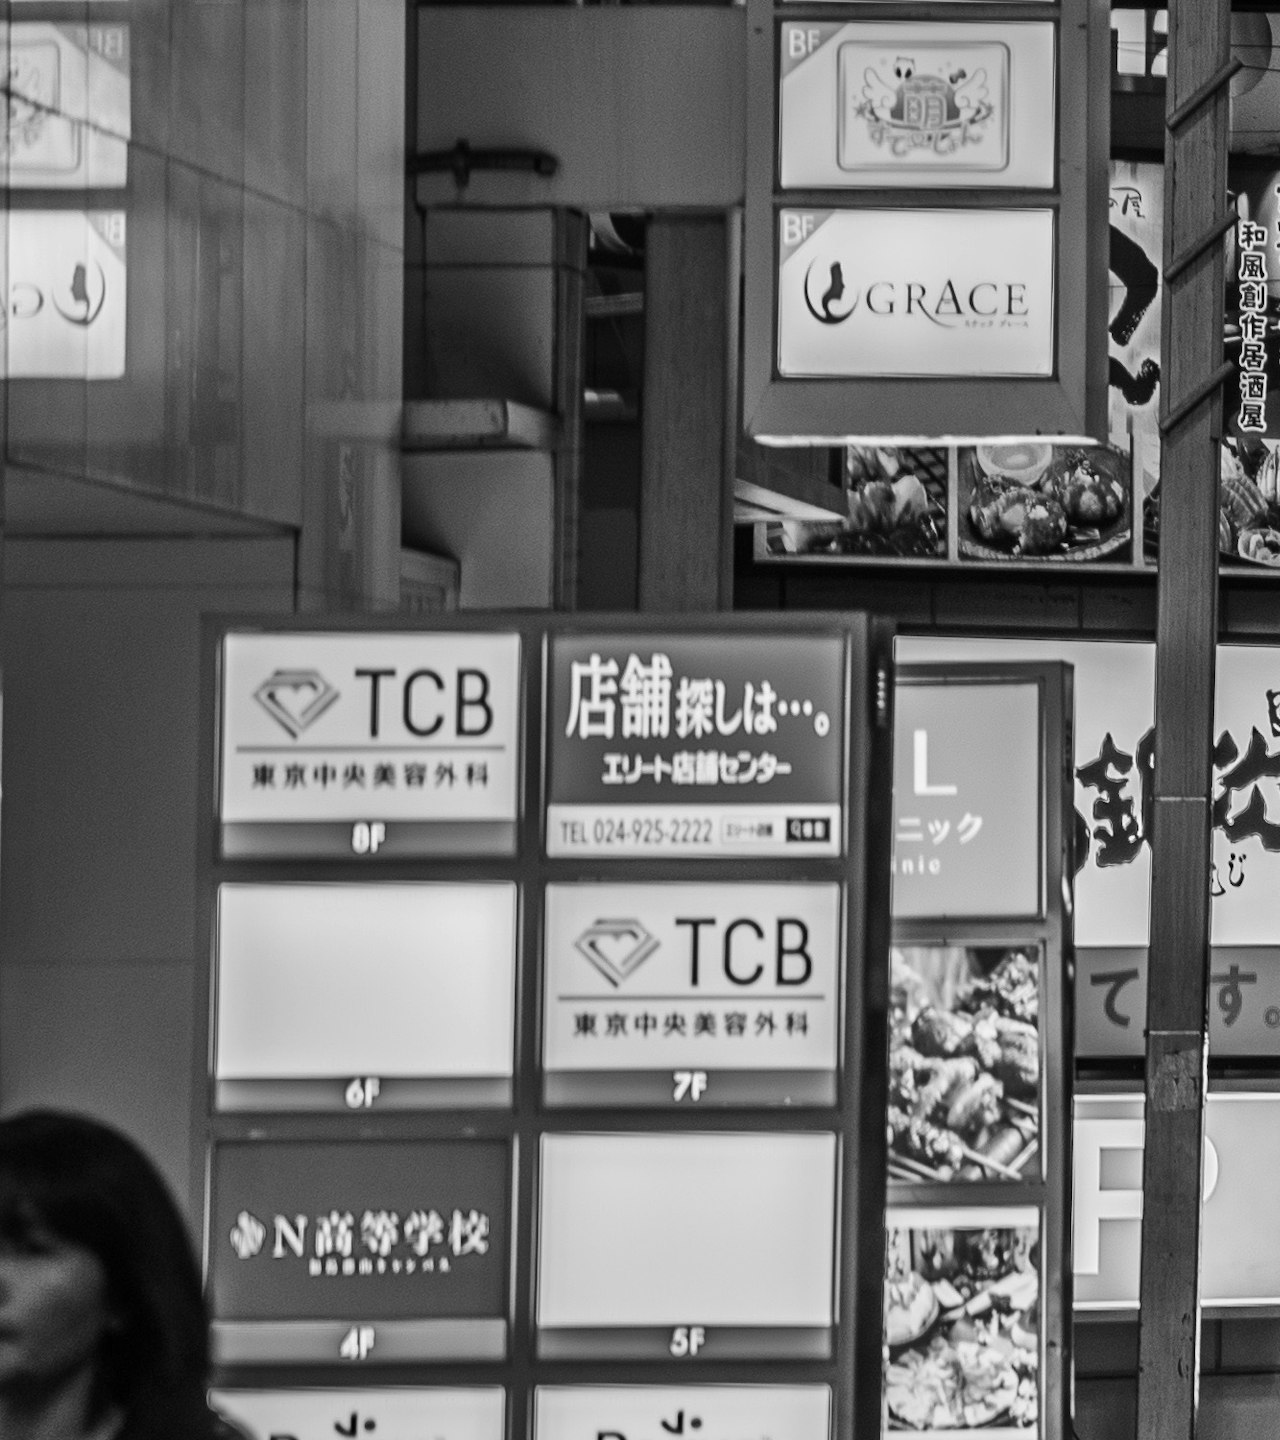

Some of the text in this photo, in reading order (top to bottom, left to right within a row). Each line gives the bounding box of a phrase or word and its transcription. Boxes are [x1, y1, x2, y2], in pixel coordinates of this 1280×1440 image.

[788, 28, 821, 60] BF
[783, 213, 815, 246] BF
[865, 278, 1030, 328] GRACE
[1238, 220, 1267, 434] 和風創作居酒屋
[354, 666, 494, 739] TCB
[251, 761, 489, 790] 東京中央美容外科
[600, 748, 793, 786] エリート店舗センター
[560, 818, 714, 844] TEL 024-925-2222
[674, 917, 815, 989] TCB
[573, 1011, 809, 1039] 東京中央美容外科
[345, 1077, 381, 1109] 6F
[672, 1071, 708, 1102] 7F
[272, 1208, 490, 1259] N高等学校
[339, 1326, 376, 1361] 4F
[669, 1326, 706, 1358] 5F
